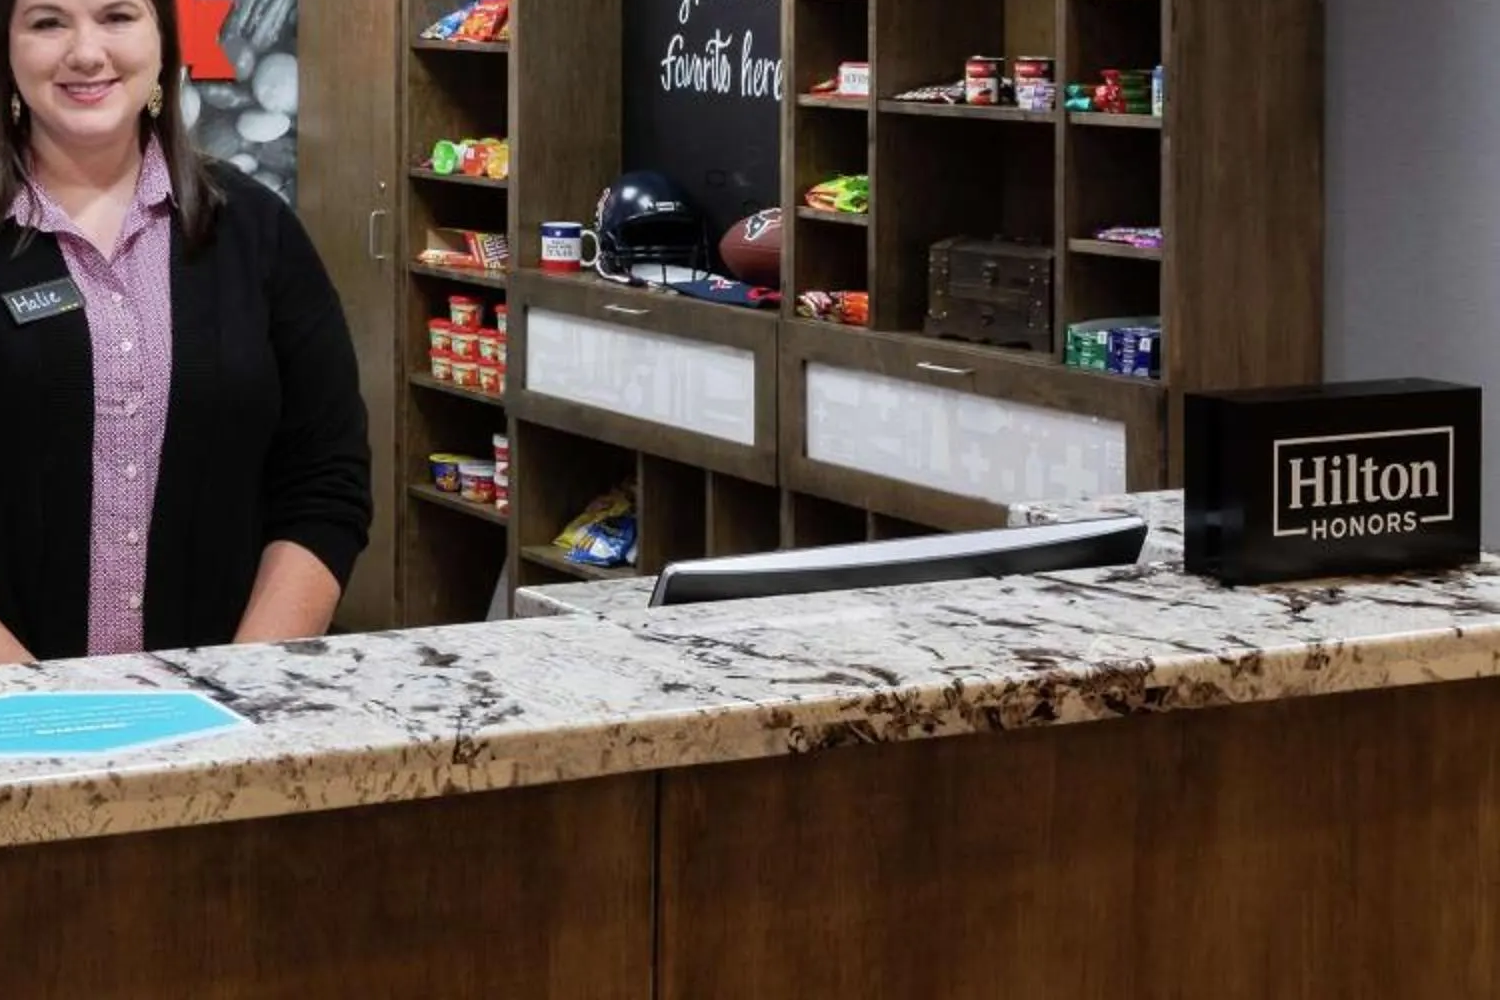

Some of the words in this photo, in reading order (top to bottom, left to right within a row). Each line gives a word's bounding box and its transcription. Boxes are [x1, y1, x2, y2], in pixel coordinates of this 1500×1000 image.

[741, 28, 784, 101] here
[1288, 453, 1440, 509] Hilton
[1311, 511, 1418, 541] HONORS
